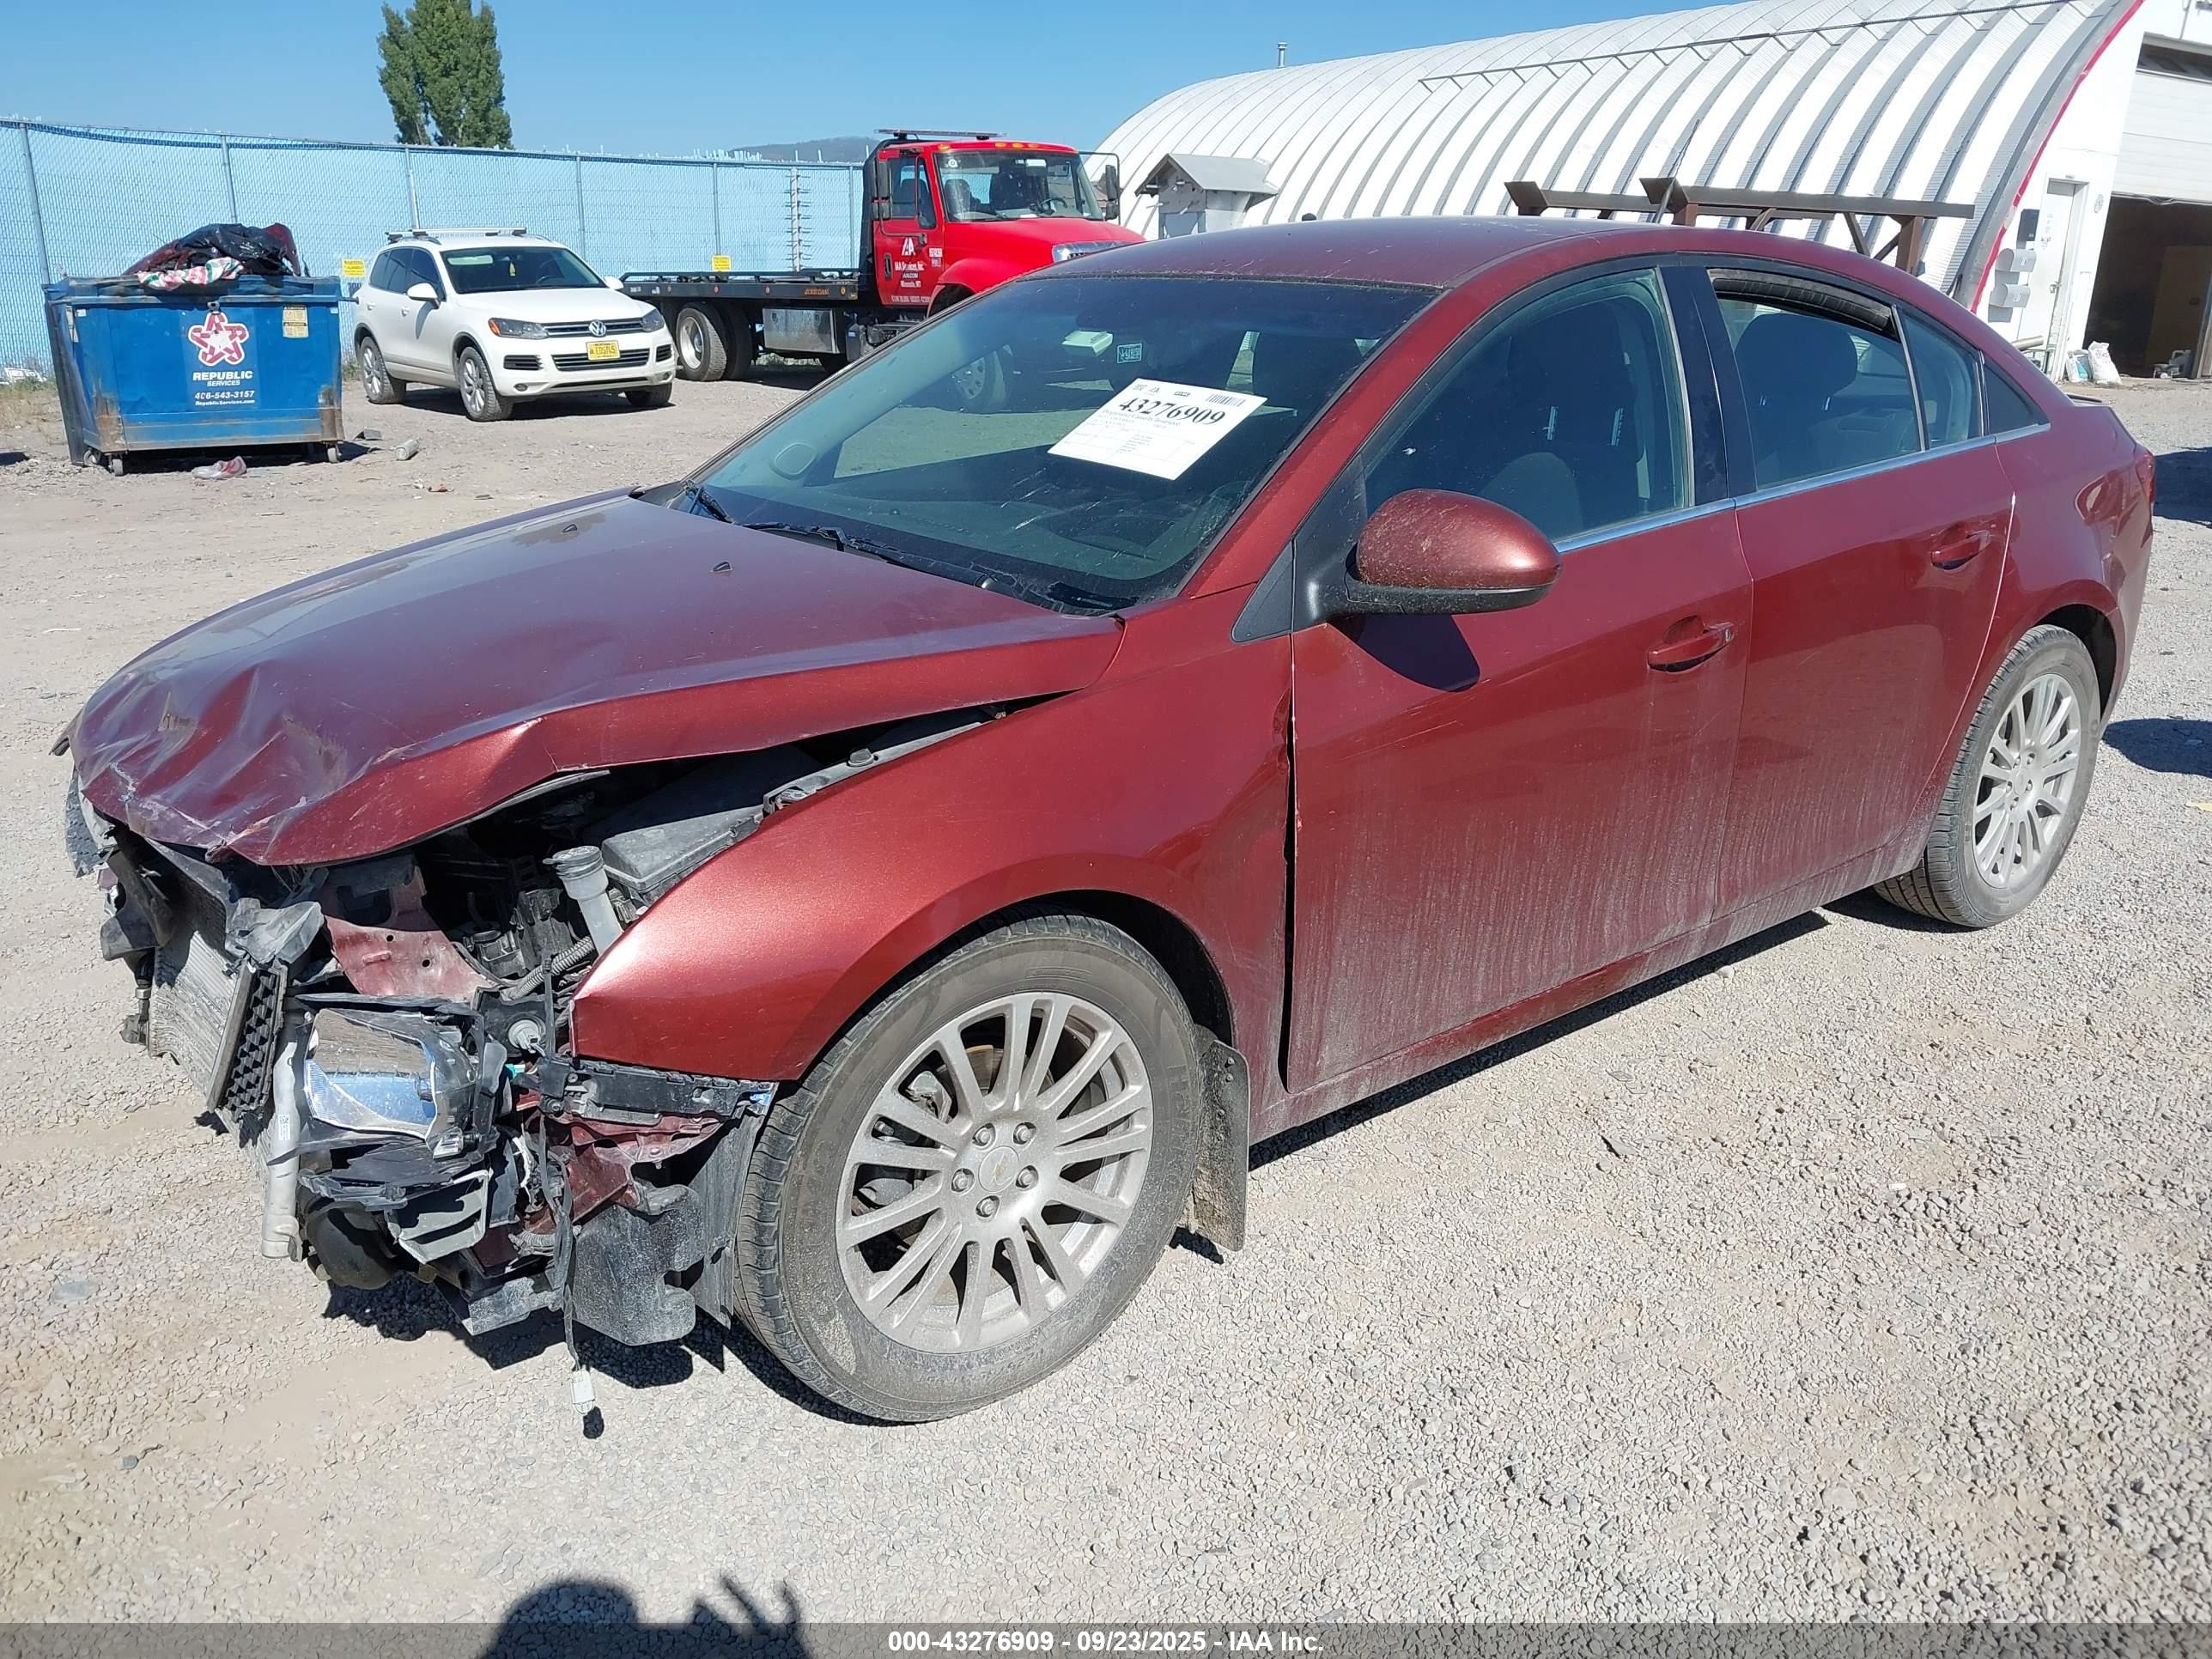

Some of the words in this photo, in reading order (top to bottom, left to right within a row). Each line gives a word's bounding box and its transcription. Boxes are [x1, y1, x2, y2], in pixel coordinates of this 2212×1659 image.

[192, 370, 253, 380] REPUBLIC
[195, 390, 255, 399] 406-543-3157
[1119, 398, 1226, 425] 43276909
